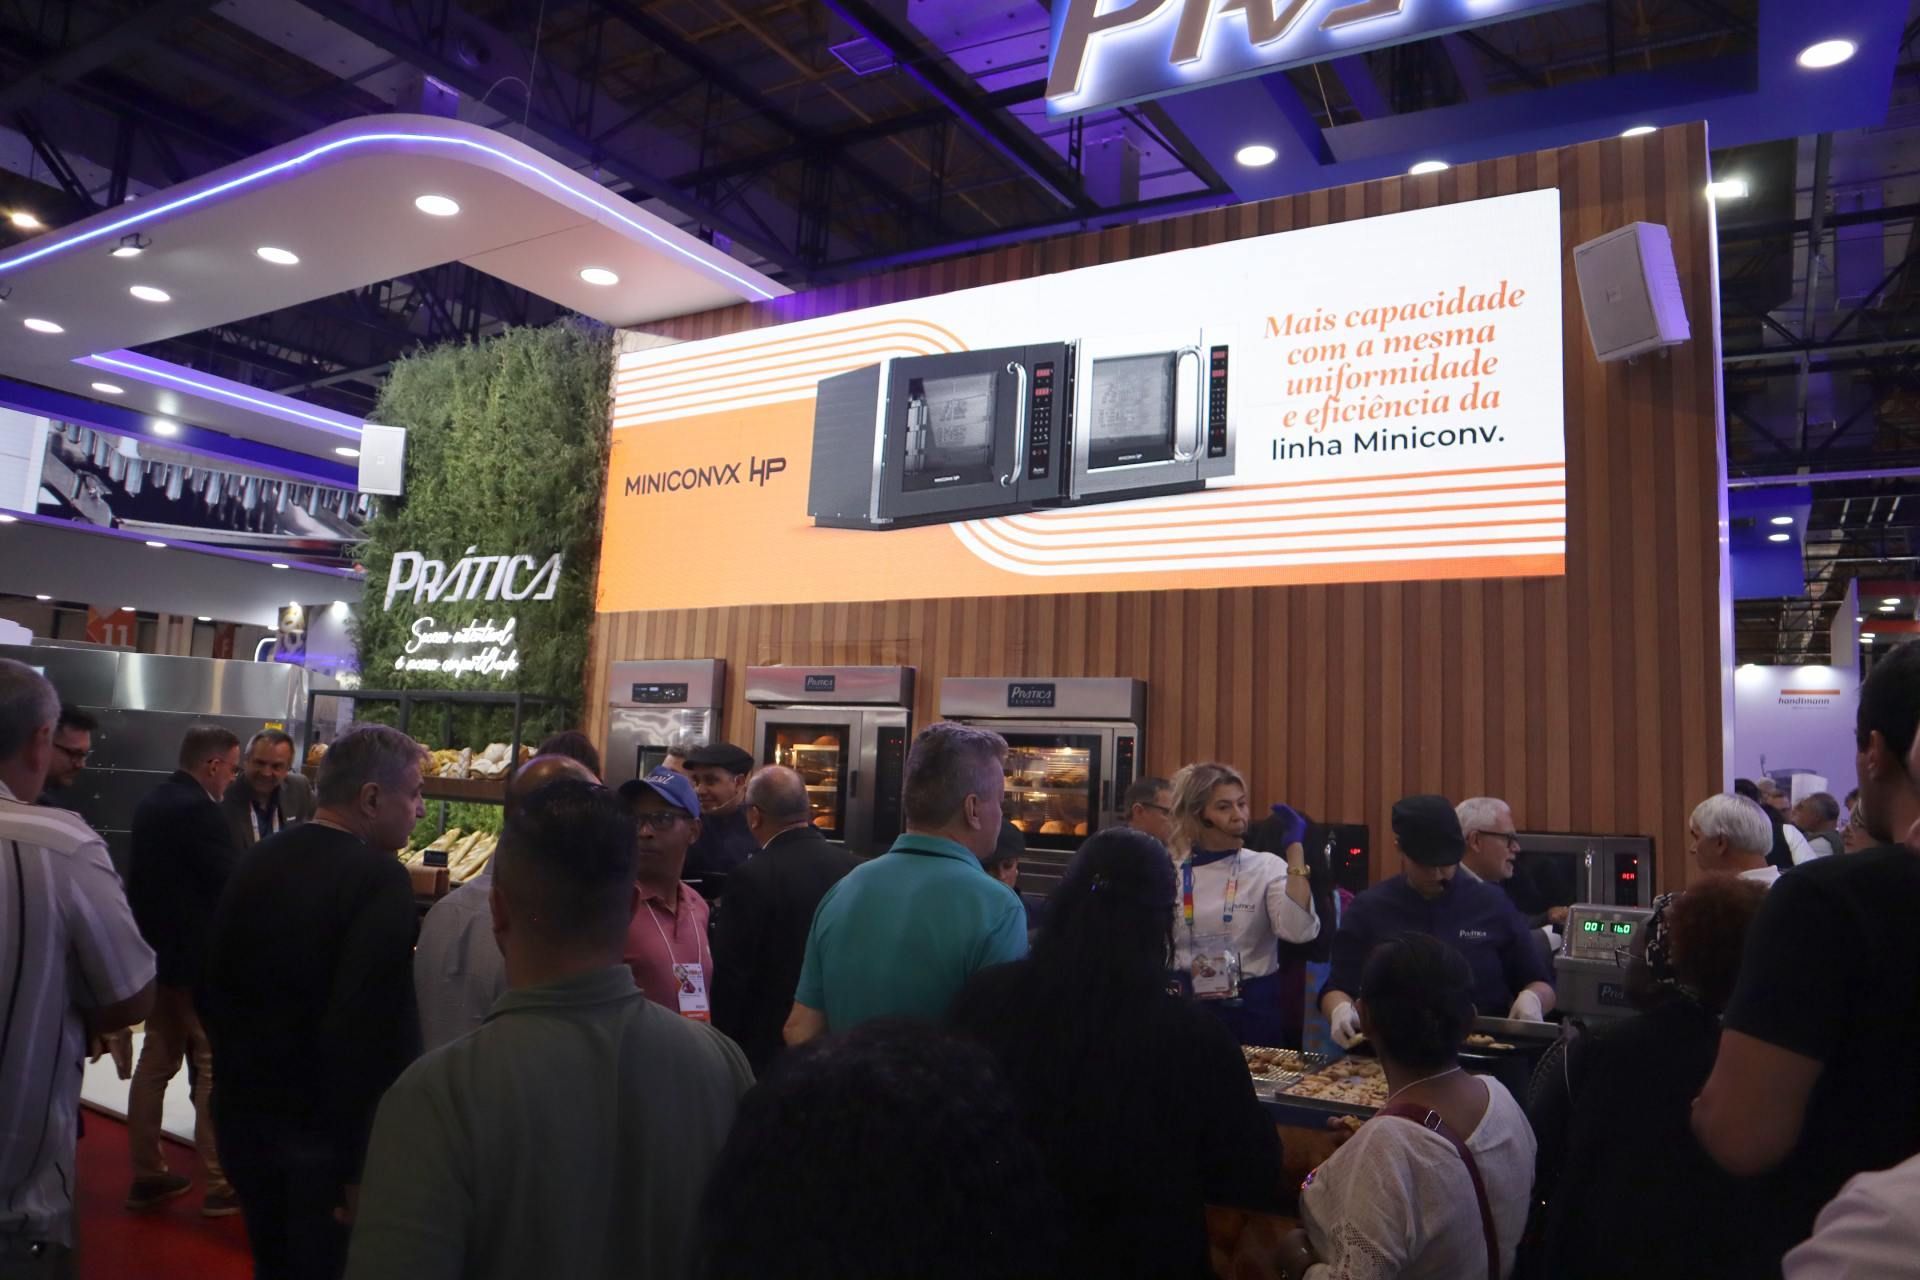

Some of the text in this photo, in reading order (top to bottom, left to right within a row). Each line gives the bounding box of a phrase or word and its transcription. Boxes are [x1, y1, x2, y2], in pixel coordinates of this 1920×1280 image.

[1264, 280, 1525, 339] Mais capacidade
[1287, 324, 1495, 365] com a mesma
[1286, 348, 1498, 398] uniformidade
[1282, 381, 1501, 433] e eficiência da
[1272, 425, 1505, 460] linha Miniconv.
[625, 456, 787, 496] MINICONVX HP
